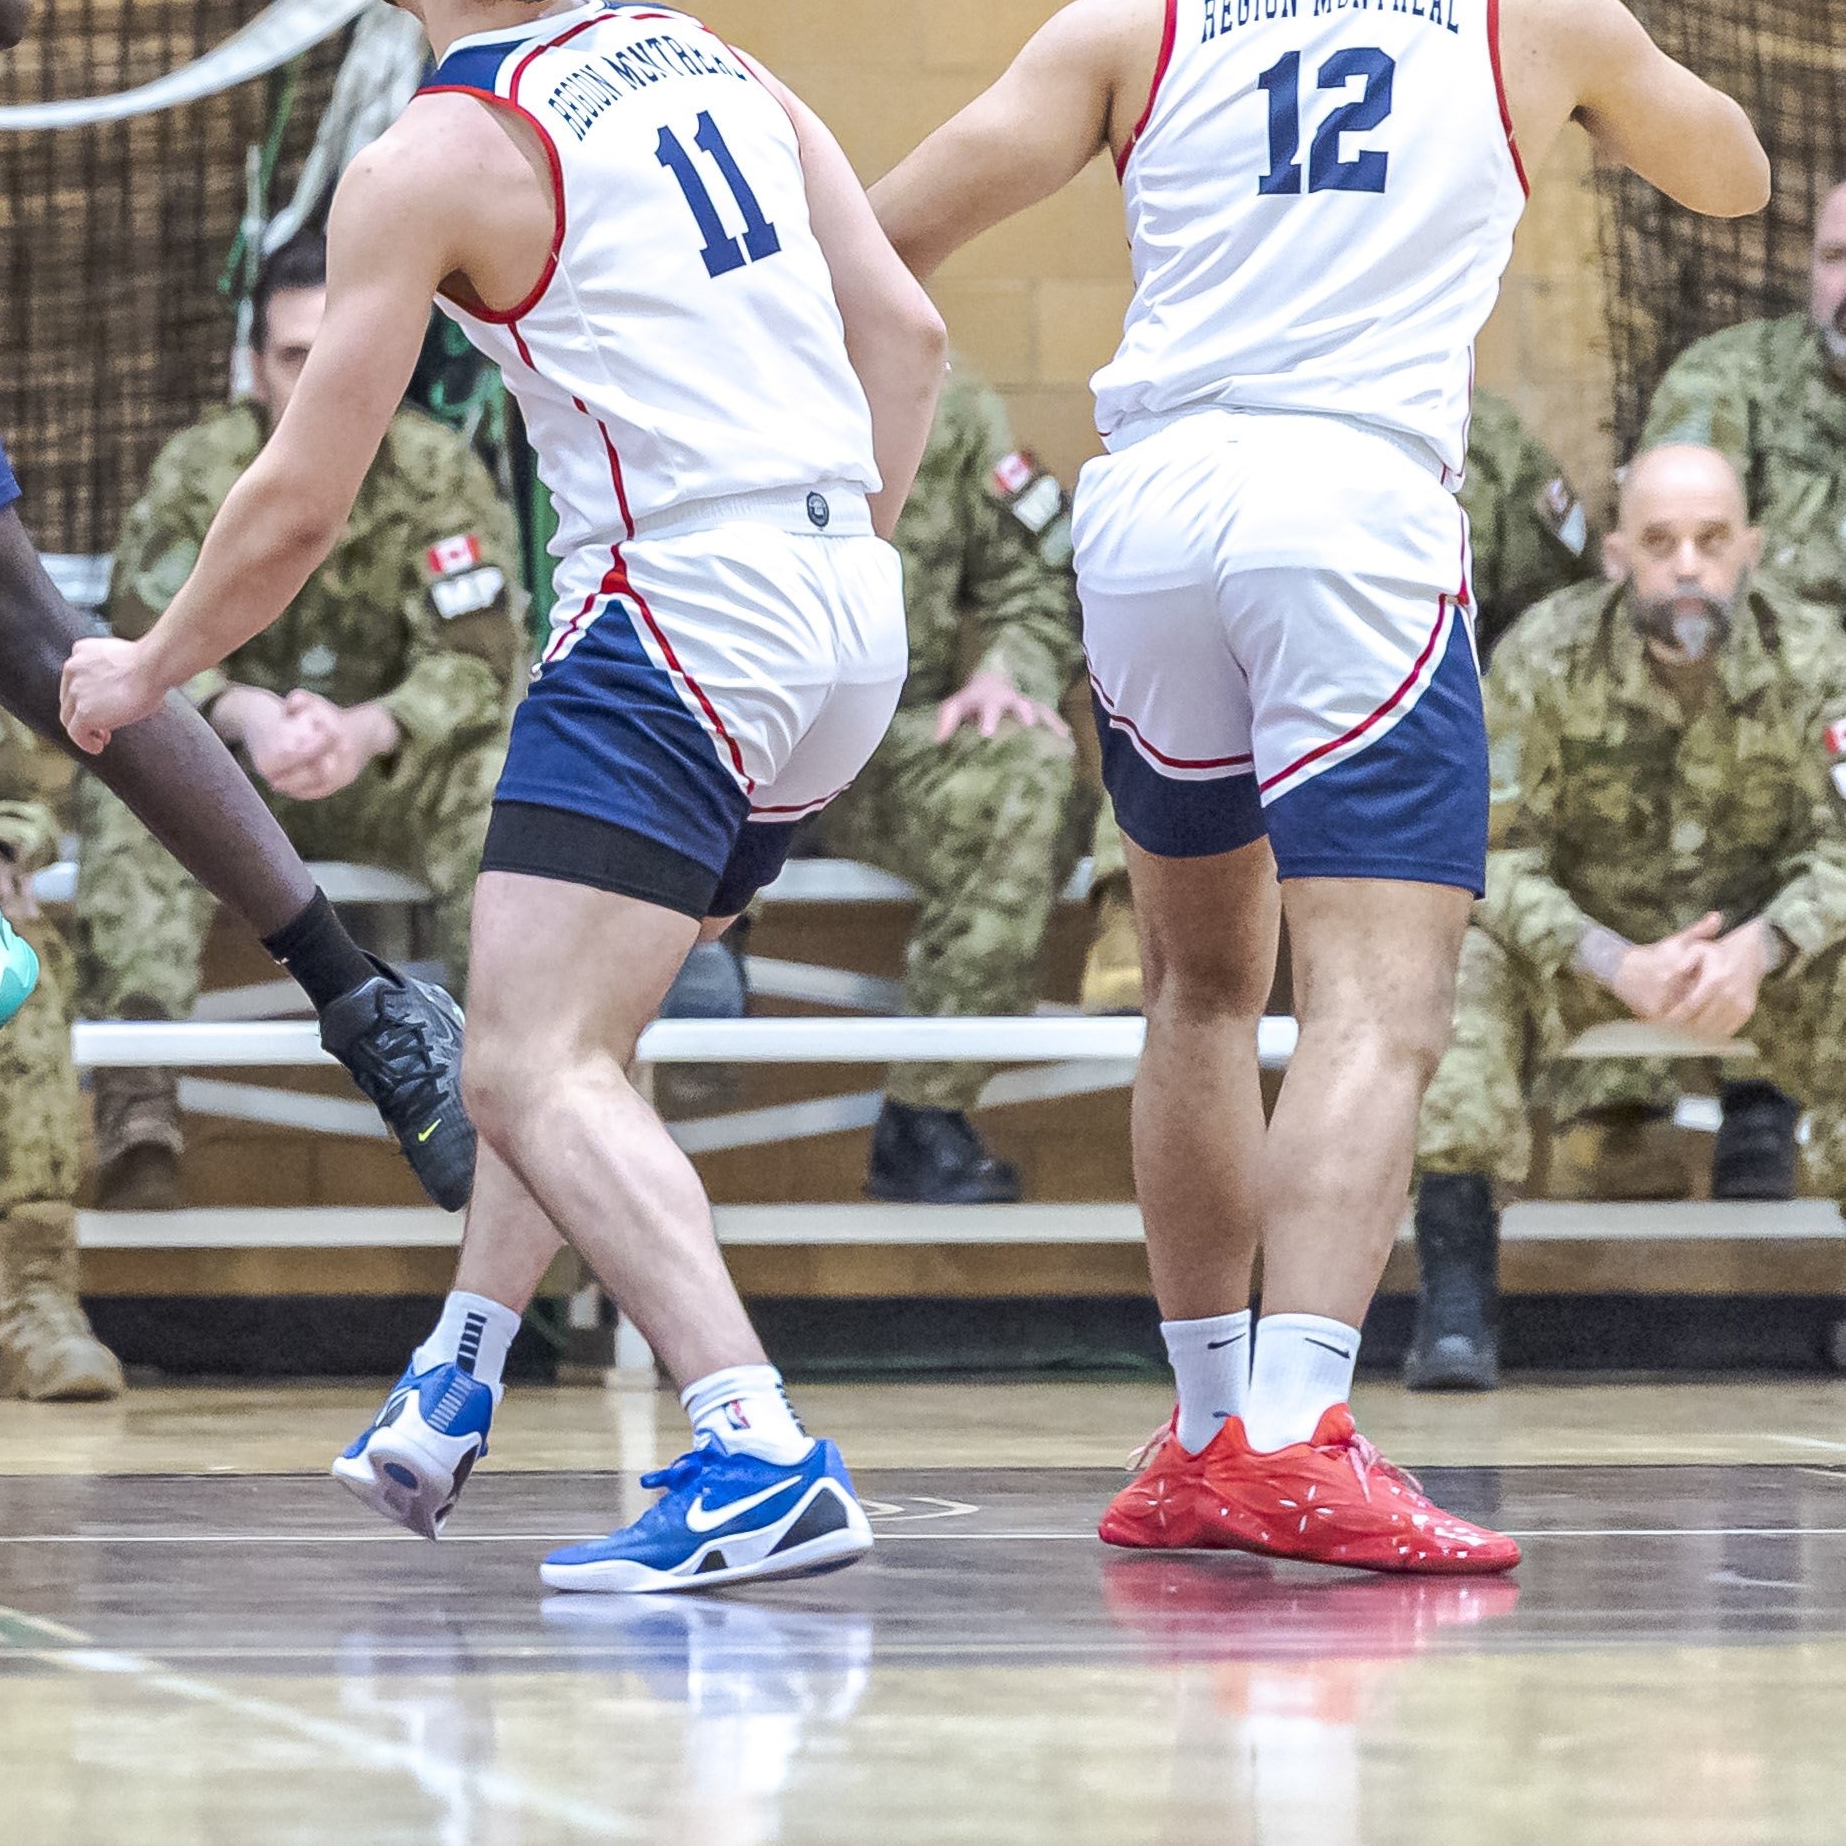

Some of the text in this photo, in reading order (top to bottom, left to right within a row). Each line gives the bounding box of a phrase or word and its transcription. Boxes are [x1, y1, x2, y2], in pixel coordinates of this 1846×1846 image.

[548, 64, 623, 141] REGION
[1256, 46, 1396, 196] 12
[654, 110, 782, 278] 11
